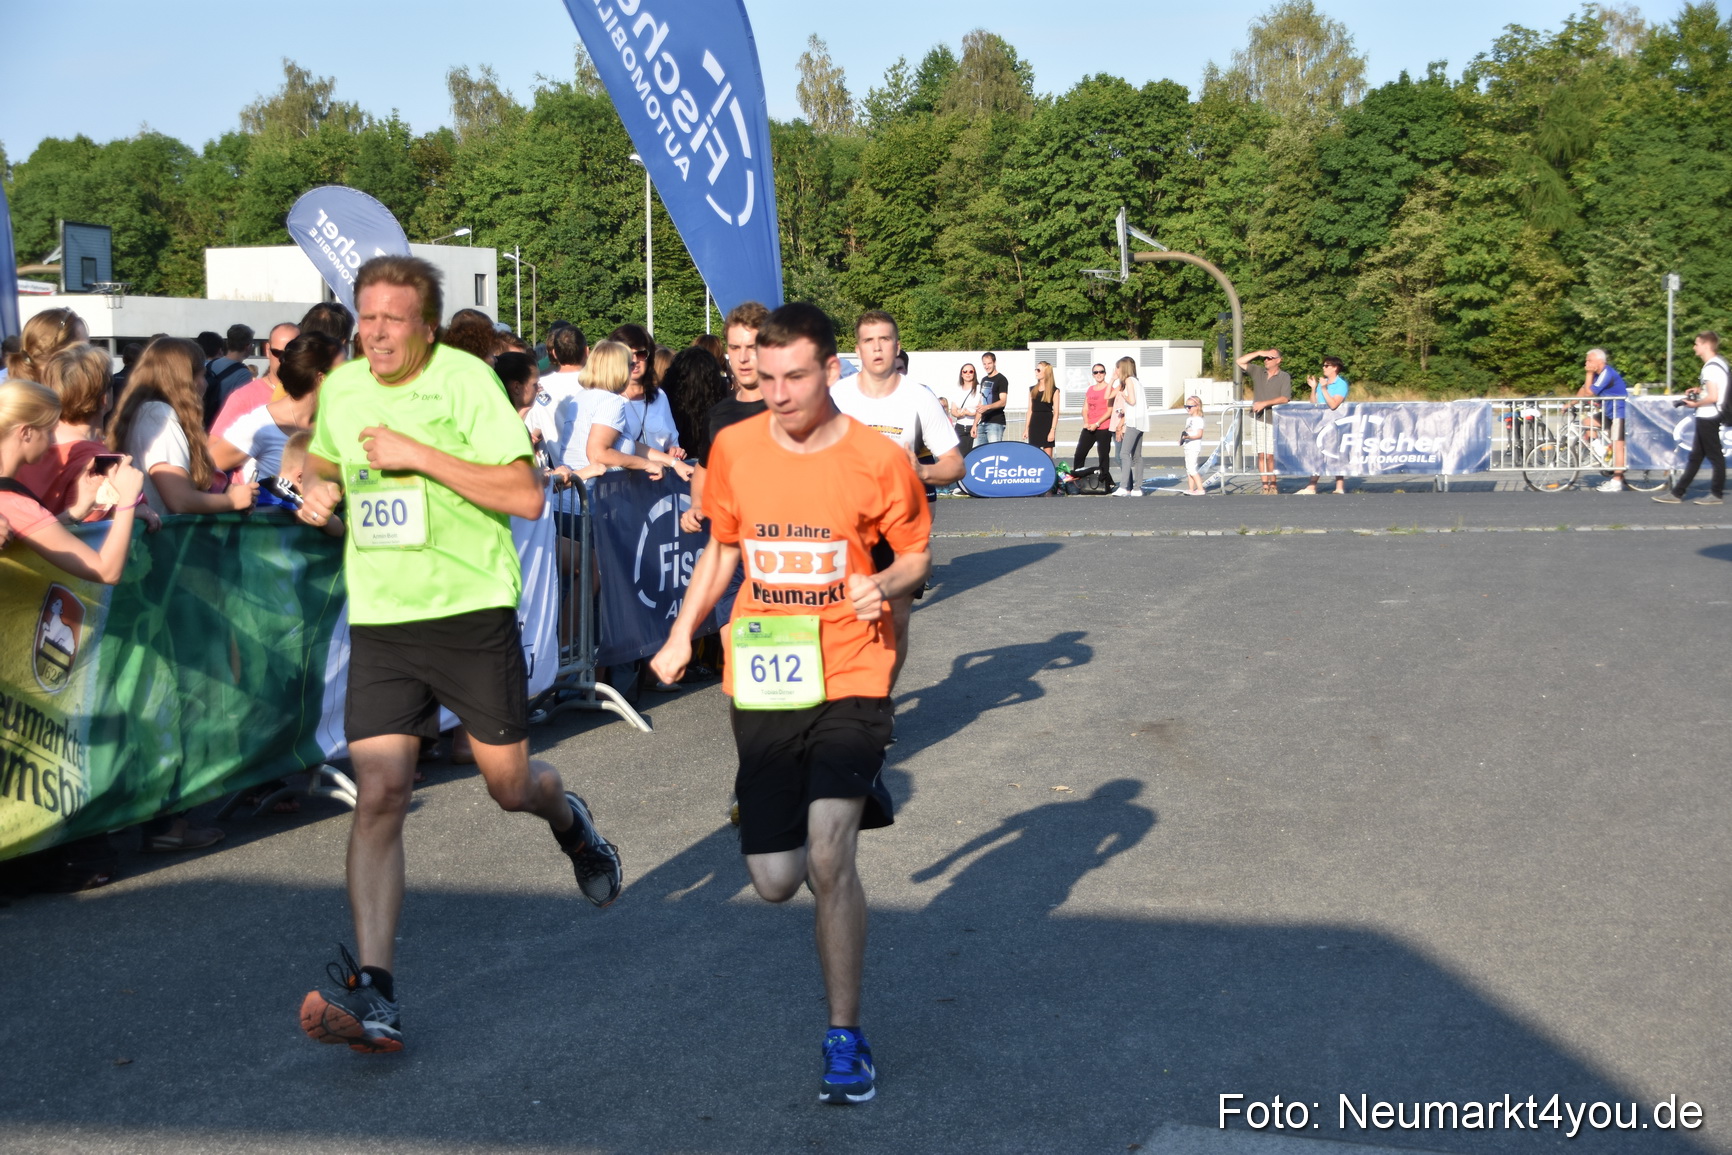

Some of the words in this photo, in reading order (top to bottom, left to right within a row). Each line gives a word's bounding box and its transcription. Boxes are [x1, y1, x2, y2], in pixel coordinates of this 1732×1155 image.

[1339, 432, 1447, 453] Fischer
[1349, 454, 1437, 464] AUTOMOBILE
[985, 465, 1045, 479] Fischer
[361, 498, 408, 527] 260
[755, 523, 779, 537] 30
[786, 523, 831, 539] Jahre
[754, 549, 839, 575] OBI
[752, 581, 846, 606] Neumarkt
[750, 653, 803, 683] 612
